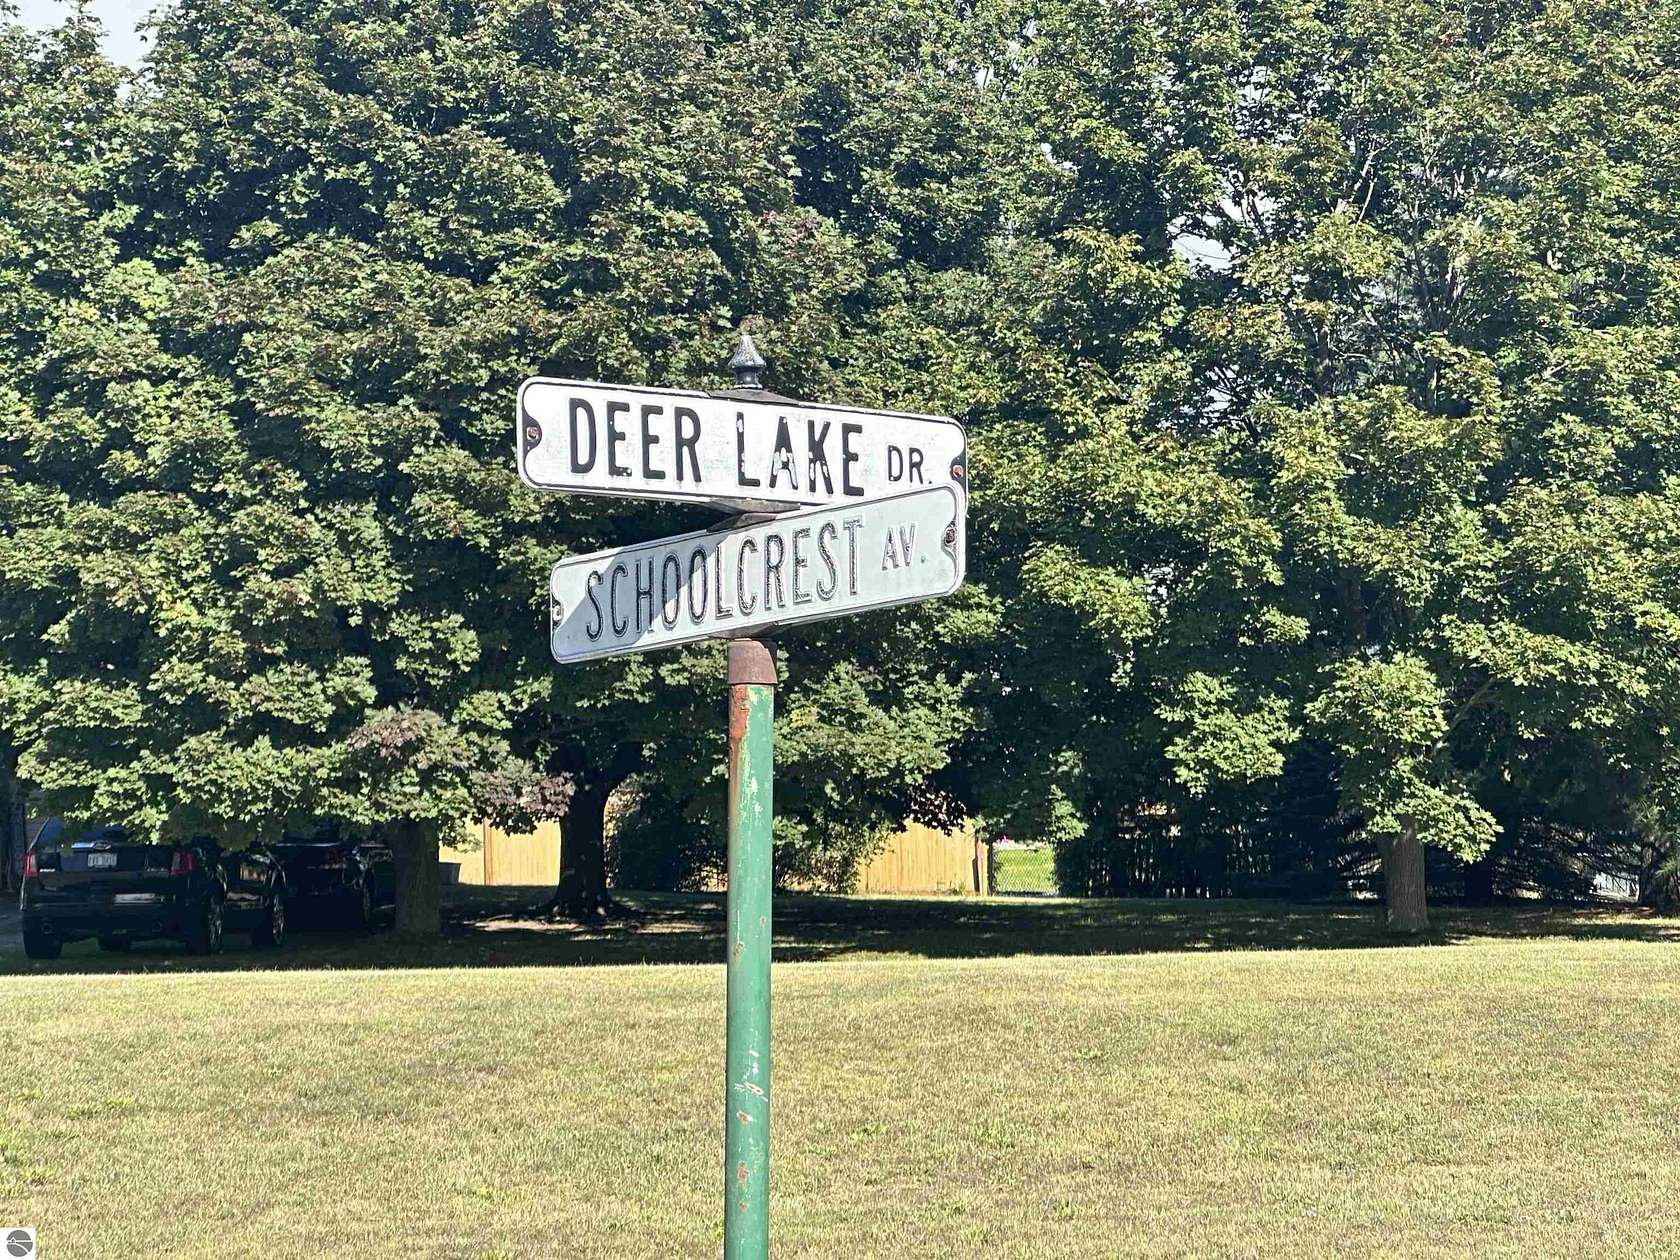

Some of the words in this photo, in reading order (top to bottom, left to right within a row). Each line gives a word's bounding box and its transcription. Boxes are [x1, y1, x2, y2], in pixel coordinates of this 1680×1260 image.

[569, 397, 702, 483] DEER
[736, 411, 864, 497] LAKE
[887, 444, 932, 485] DR.
[585, 514, 863, 642] SCHOOLCREST
[881, 523, 927, 572] AV.
